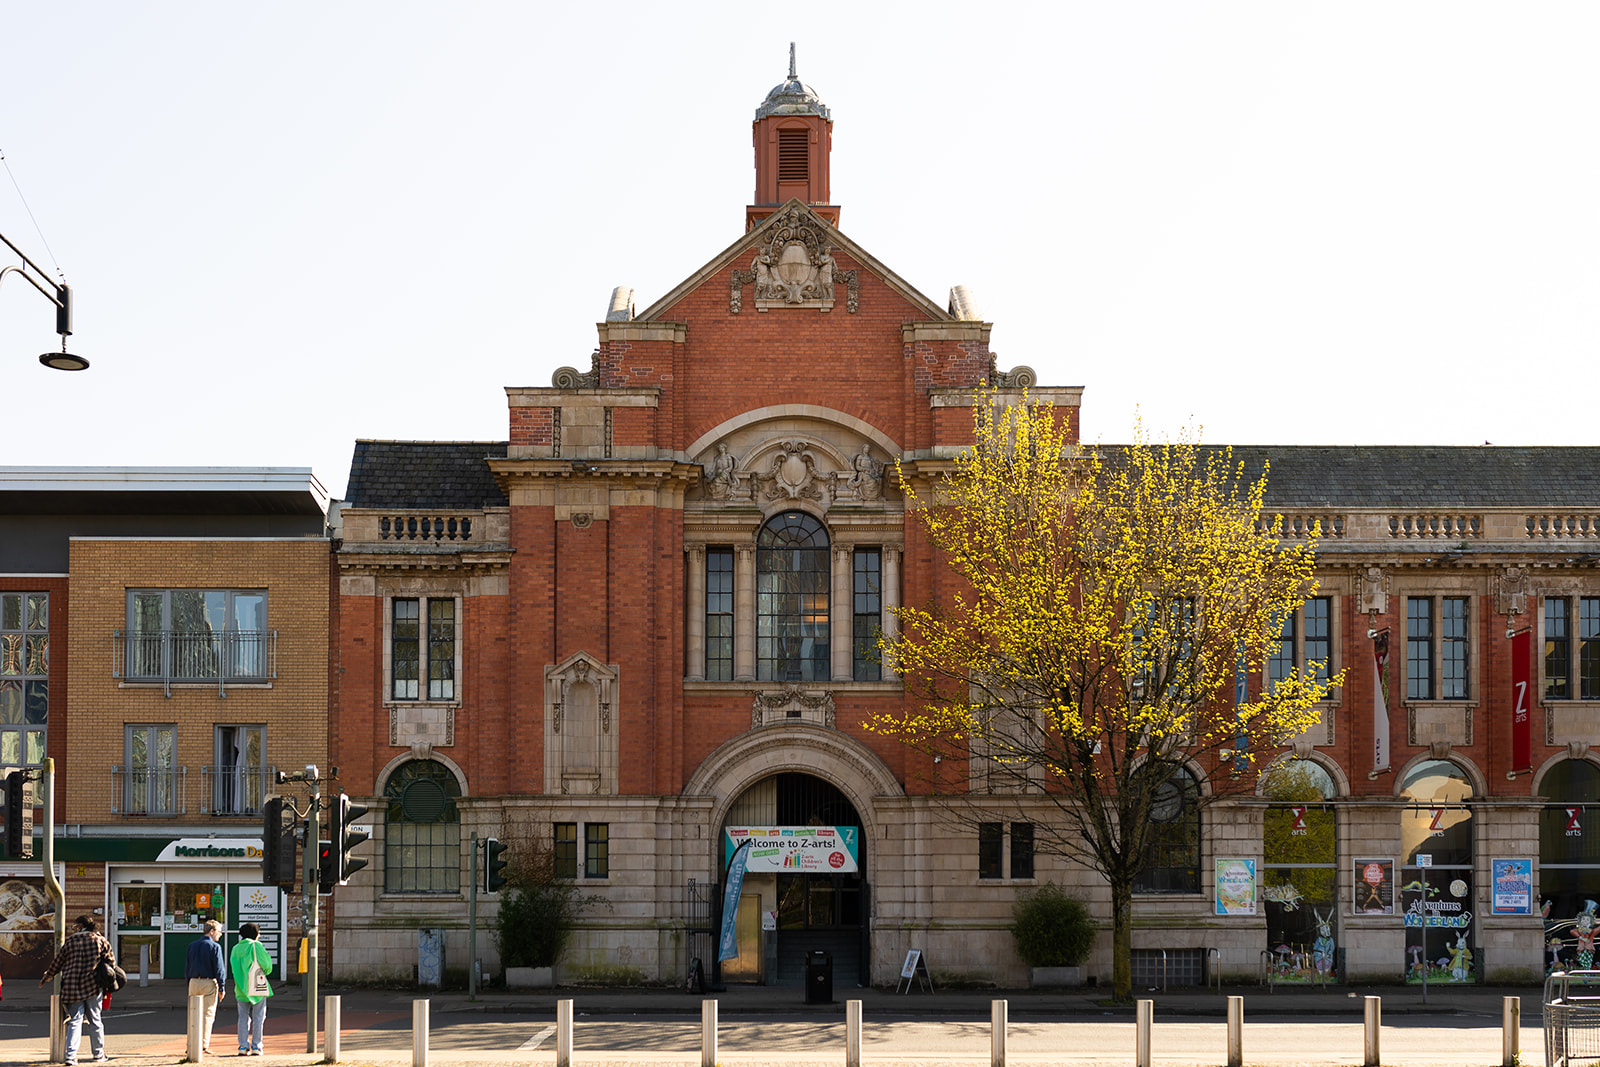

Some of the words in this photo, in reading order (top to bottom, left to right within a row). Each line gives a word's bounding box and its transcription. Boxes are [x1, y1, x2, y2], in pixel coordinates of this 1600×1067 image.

[1516, 681, 1527, 714] Z
[846, 829, 854, 841] Z
[736, 838, 785, 848] Welcome
[788, 839, 798, 848] to
[801, 839, 836, 848] Z-arts!
[175, 844, 245, 857] Morrisons
[246, 846, 263, 857] Da
